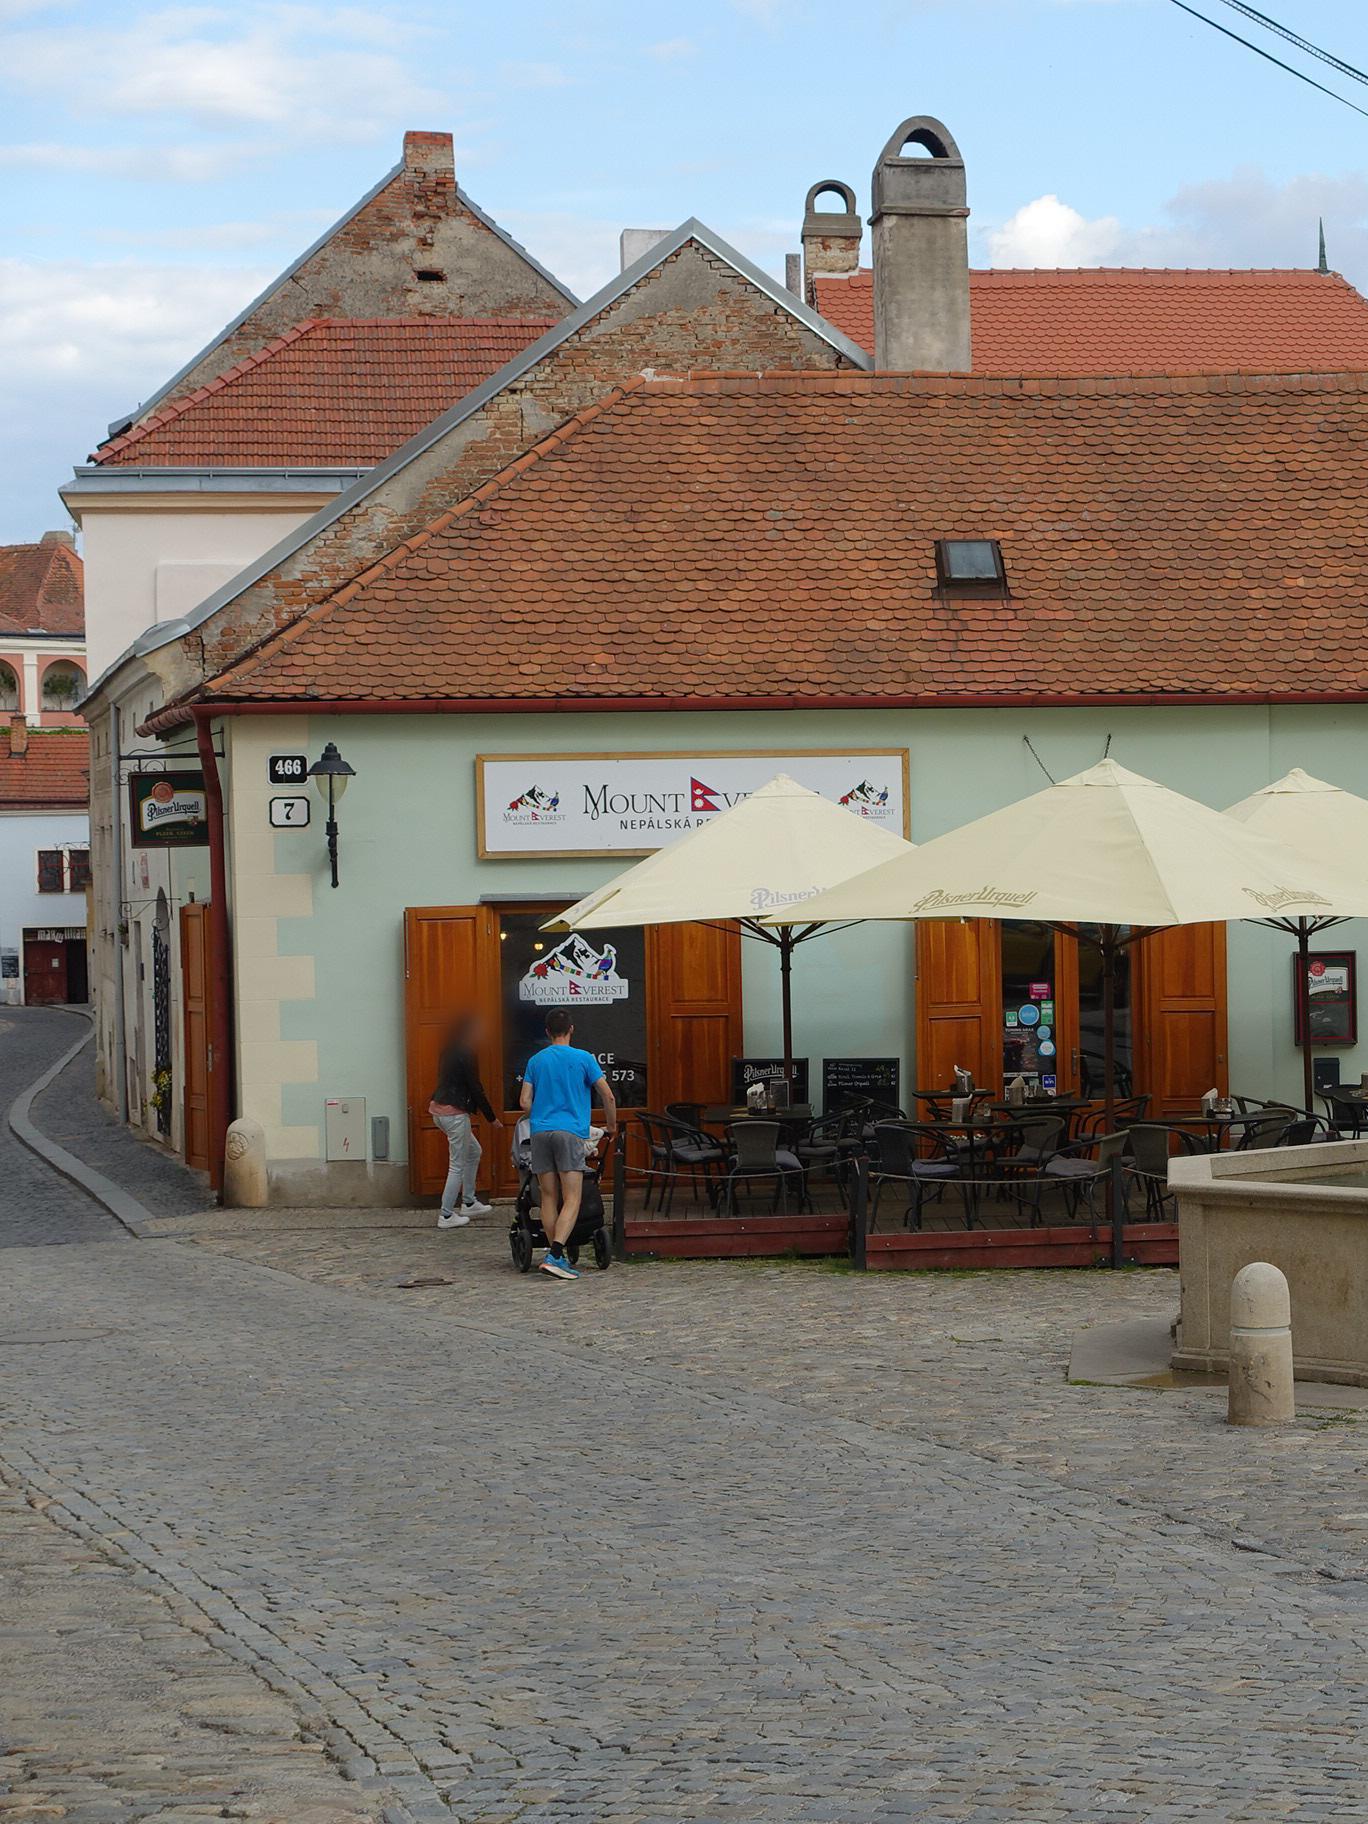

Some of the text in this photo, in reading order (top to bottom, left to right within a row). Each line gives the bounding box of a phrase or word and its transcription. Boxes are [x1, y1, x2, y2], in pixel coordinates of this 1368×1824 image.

[275, 759, 302, 775] 466
[147, 801, 200, 821] Pilsner Urquell
[284, 802, 295, 820] 7
[583, 784, 685, 821] MOUNT
[619, 816, 692, 830] NEPÁLSKÁ
[909, 885, 1038, 914] Pilsner Urquell
[523, 982, 568, 999] MOUNT
[611, 1070, 635, 1081] 573
[744, 1064, 771, 1083] Pilsner
